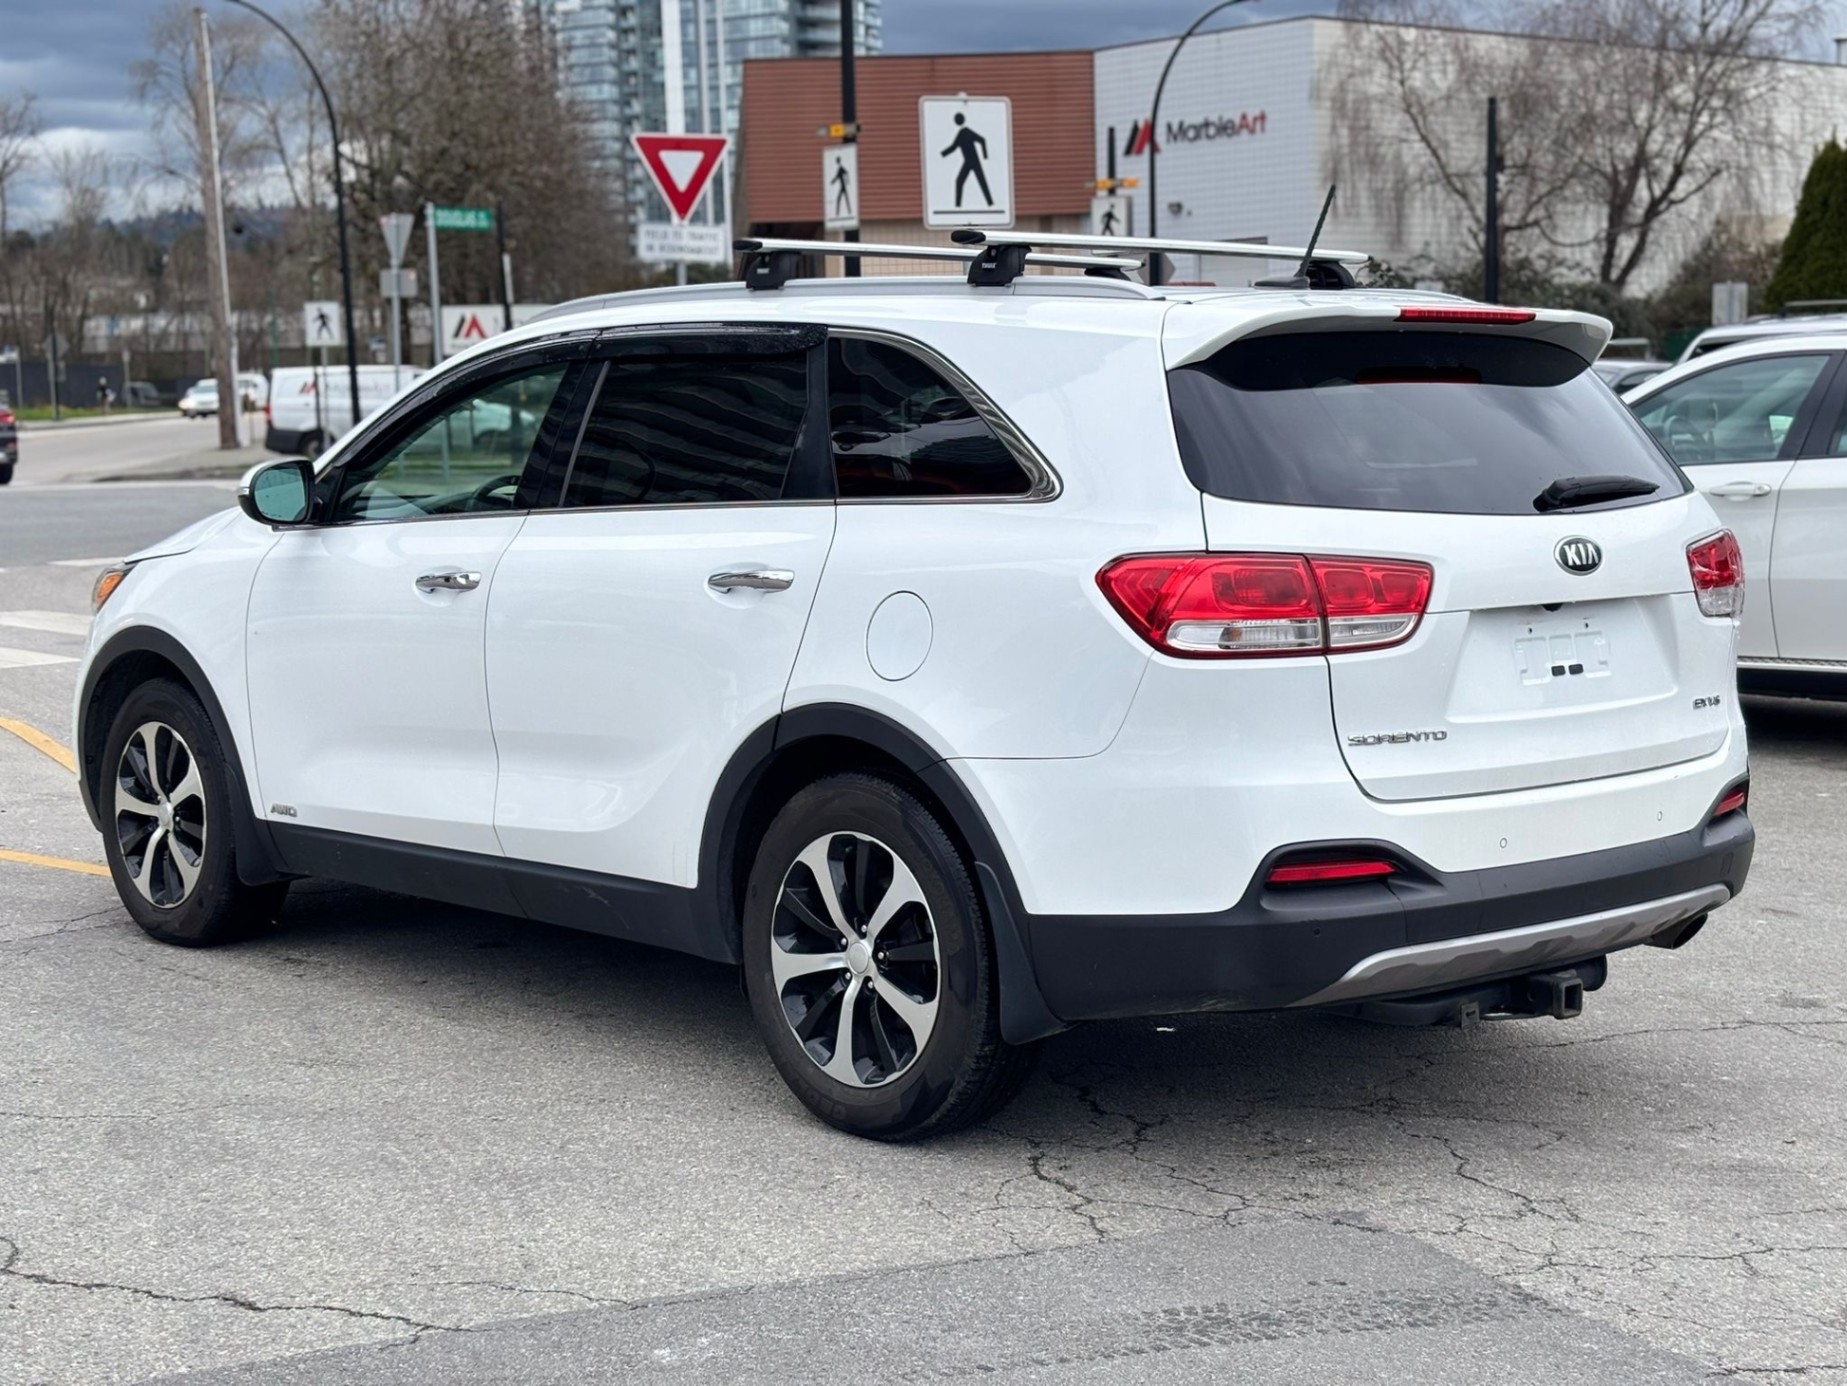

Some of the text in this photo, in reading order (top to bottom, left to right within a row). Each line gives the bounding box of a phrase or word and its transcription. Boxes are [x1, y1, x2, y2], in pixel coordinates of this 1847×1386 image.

[1165, 109, 1267, 144] MarbleArt
[1563, 542, 1599, 566] KIA
[1347, 730, 1447, 746] SORENTO
